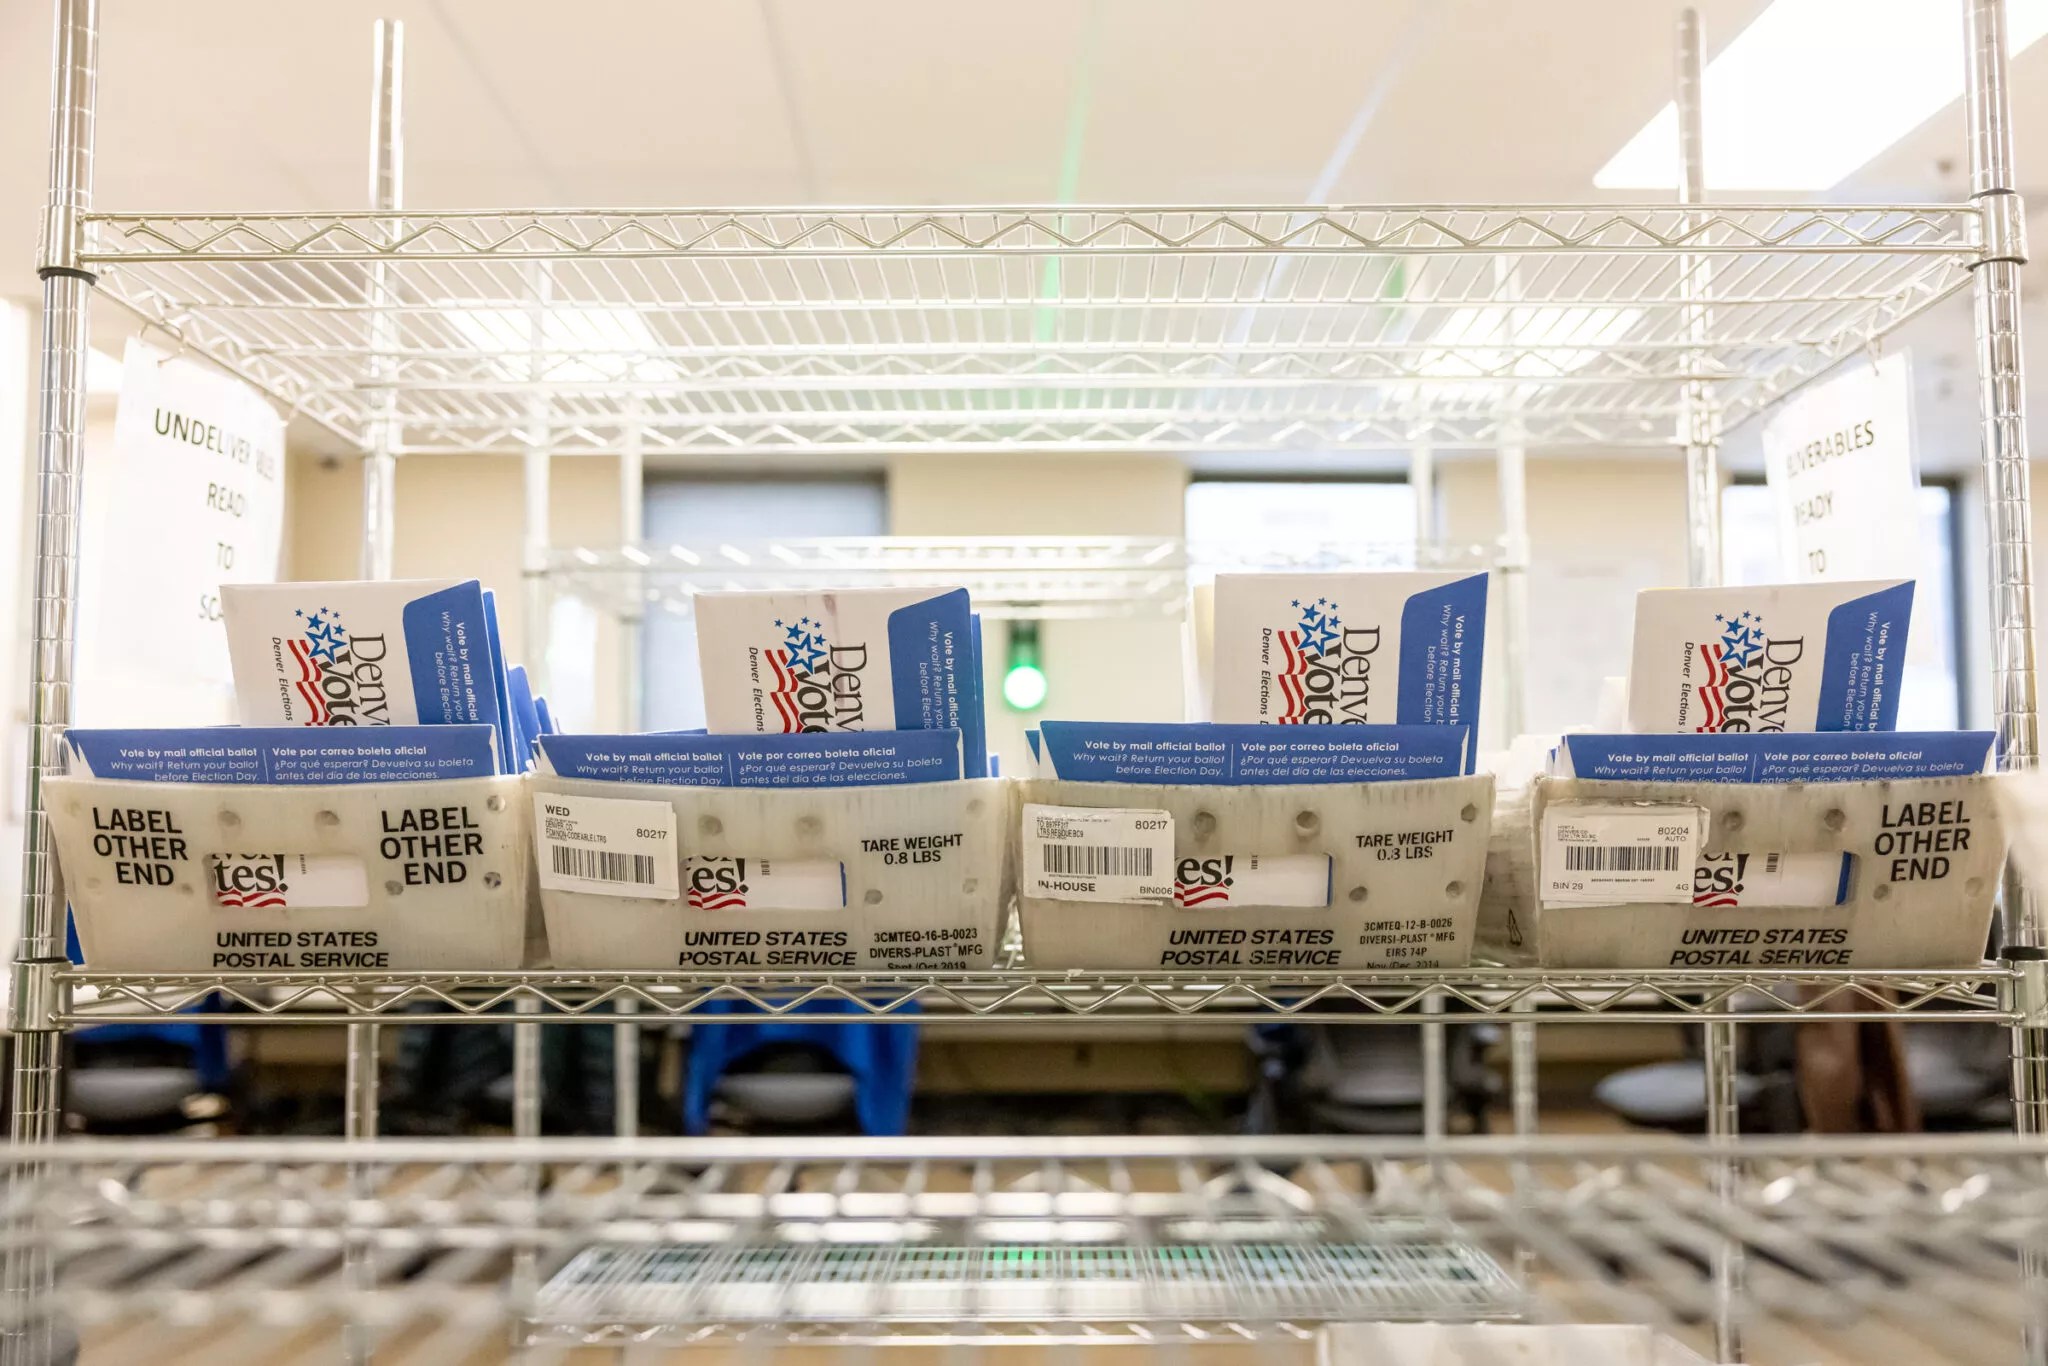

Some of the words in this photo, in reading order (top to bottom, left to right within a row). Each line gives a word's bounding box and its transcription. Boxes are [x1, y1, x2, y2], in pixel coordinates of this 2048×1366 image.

[207, 482, 246, 518] READ
[217, 542, 234, 570] TO
[1809, 550, 1826, 574] TO
[1454, 615, 1465, 638] Vote
[1262, 627, 1272, 666] Denver
[1454, 642, 1463, 658] by
[749, 647, 760, 683] Denver
[1683, 642, 1694, 678] Denver
[1452, 657, 1463, 681] mail
[271, 637, 284, 674] Denver
[279, 678, 293, 721] Elections
[349, 633, 390, 725] Denv
[829, 642, 868, 732] Denv
[1303, 642, 1342, 725] Vote
[1260, 670, 1271, 716] Elections
[1451, 682, 1462, 716] official
[1720, 653, 1764, 733] Vote
[752, 688, 764, 732] Elections
[1678, 683, 1692, 726] Elections
[120, 749, 144, 758] Vote
[148, 749, 160, 758] by
[164, 749, 186, 757] mail
[190, 748, 224, 757] official
[227, 748, 258, 757] ballot
[272, 748, 297, 757] Vote
[300, 748, 317, 758] por
[321, 747, 354, 756] correo
[358, 747, 391, 756] boleta
[394, 746, 427, 755] oficial
[1085, 741, 1109, 750] Vote
[1113, 742, 1126, 751] by
[1130, 742, 1152, 750] mail
[1156, 742, 1191, 751] official
[1195, 743, 1226, 751] ballot
[1241, 743, 1267, 751] Vote
[1270, 744, 1286, 753] por
[1328, 743, 1362, 751] boleta
[1366, 743, 1399, 751] oficial
[586, 753, 610, 761] Vote
[613, 753, 626, 762] by
[629, 753, 651, 761] mail
[654, 753, 689, 761] official
[692, 753, 723, 761] ballot
[738, 752, 762, 761] Vote
[766, 753, 783, 762] por
[787, 752, 822, 760] correo
[825, 749, 860, 758] boleta
[863, 748, 896, 757] oficial
[1073, 753, 1095, 762] Why
[1099, 754, 1127, 762] wait?
[1131, 754, 1165, 763] Return
[1168, 756, 1191, 764] your
[1194, 755, 1225, 764] ballot
[1241, 756, 1263, 766] ¿Por
[1267, 755, 1287, 766] qué
[1292, 755, 1337, 765] esperar?
[1341, 755, 1391, 764] Devuelva
[1409, 755, 1443, 763] boleta
[1608, 754, 1632, 762] Vote
[1636, 754, 1649, 763] by
[1653, 754, 1675, 762] mail
[1679, 754, 1714, 762] official
[1718, 753, 1748, 762] ballot
[1764, 753, 1789, 761] Vote
[1792, 753, 1809, 763] por
[1813, 753, 1848, 761] correo
[1851, 752, 1885, 760] boleta
[1889, 752, 1922, 760] oficial
[1116, 766, 1151, 774] before
[1155, 766, 1196, 775] Election
[1200, 767, 1224, 776] Day.
[1240, 768, 1269, 776] antes
[1313, 767, 1327, 775] de
[1330, 767, 1344, 775] las
[1347, 767, 1407, 776] elecciones.
[545, 804, 570, 816] WED
[1881, 801, 1971, 828] LABEL
[93, 807, 183, 834] LABEL
[381, 806, 479, 833] LABEL
[1135, 821, 1168, 830] 80217
[636, 828, 668, 840] 80217
[1658, 826, 1689, 835] 80204
[380, 833, 484, 860] OTHER
[862, 839, 900, 852] TARE
[904, 834, 963, 850] WEIGHT
[1356, 835, 1392, 848] TARE
[1397, 830, 1454, 845] WEIGHT
[1874, 828, 1971, 856] OTHER
[93, 834, 189, 861] OTHER
[1405, 846, 1433, 858] LBS
[884, 853, 908, 866] 0.8
[913, 850, 942, 864] LBS
[115, 861, 175, 886] END
[404, 861, 467, 886] END
[691, 858, 749, 894] es!
[1175, 855, 1234, 887] es!
[1693, 854, 1750, 893] es!
[1890, 857, 1950, 882] END
[1038, 880, 1096, 892] IN-HOUSE
[1139, 886, 1173, 895] BIN006
[1552, 882, 1570, 890] BIN
[1675, 883, 1689, 891] 4G
[217, 932, 291, 947] UNITED
[297, 931, 378, 947] STATES
[684, 932, 760, 946] UNITED
[766, 931, 848, 946] STATES
[1170, 930, 1246, 945] UNITED
[1250, 929, 1334, 945] STATES
[1436, 932, 1455, 942] MFG
[1681, 929, 1759, 944] UNITED
[1763, 928, 1848, 944] STATES
[958, 944, 983, 956] MFG
[1161, 951, 1242, 965] POSTAL
[1250, 950, 1341, 965] SERVICE
[1386, 948, 1407, 957] EIRS
[1411, 947, 1427, 957] 74P
[1670, 950, 1754, 965] POSTAL
[1758, 950, 1853, 965] SERVICE
[213, 953, 295, 967] POSTAL
[300, 952, 389, 967] SERVICE
[679, 952, 761, 966] POSTAL
[766, 951, 858, 966] SERVICE
